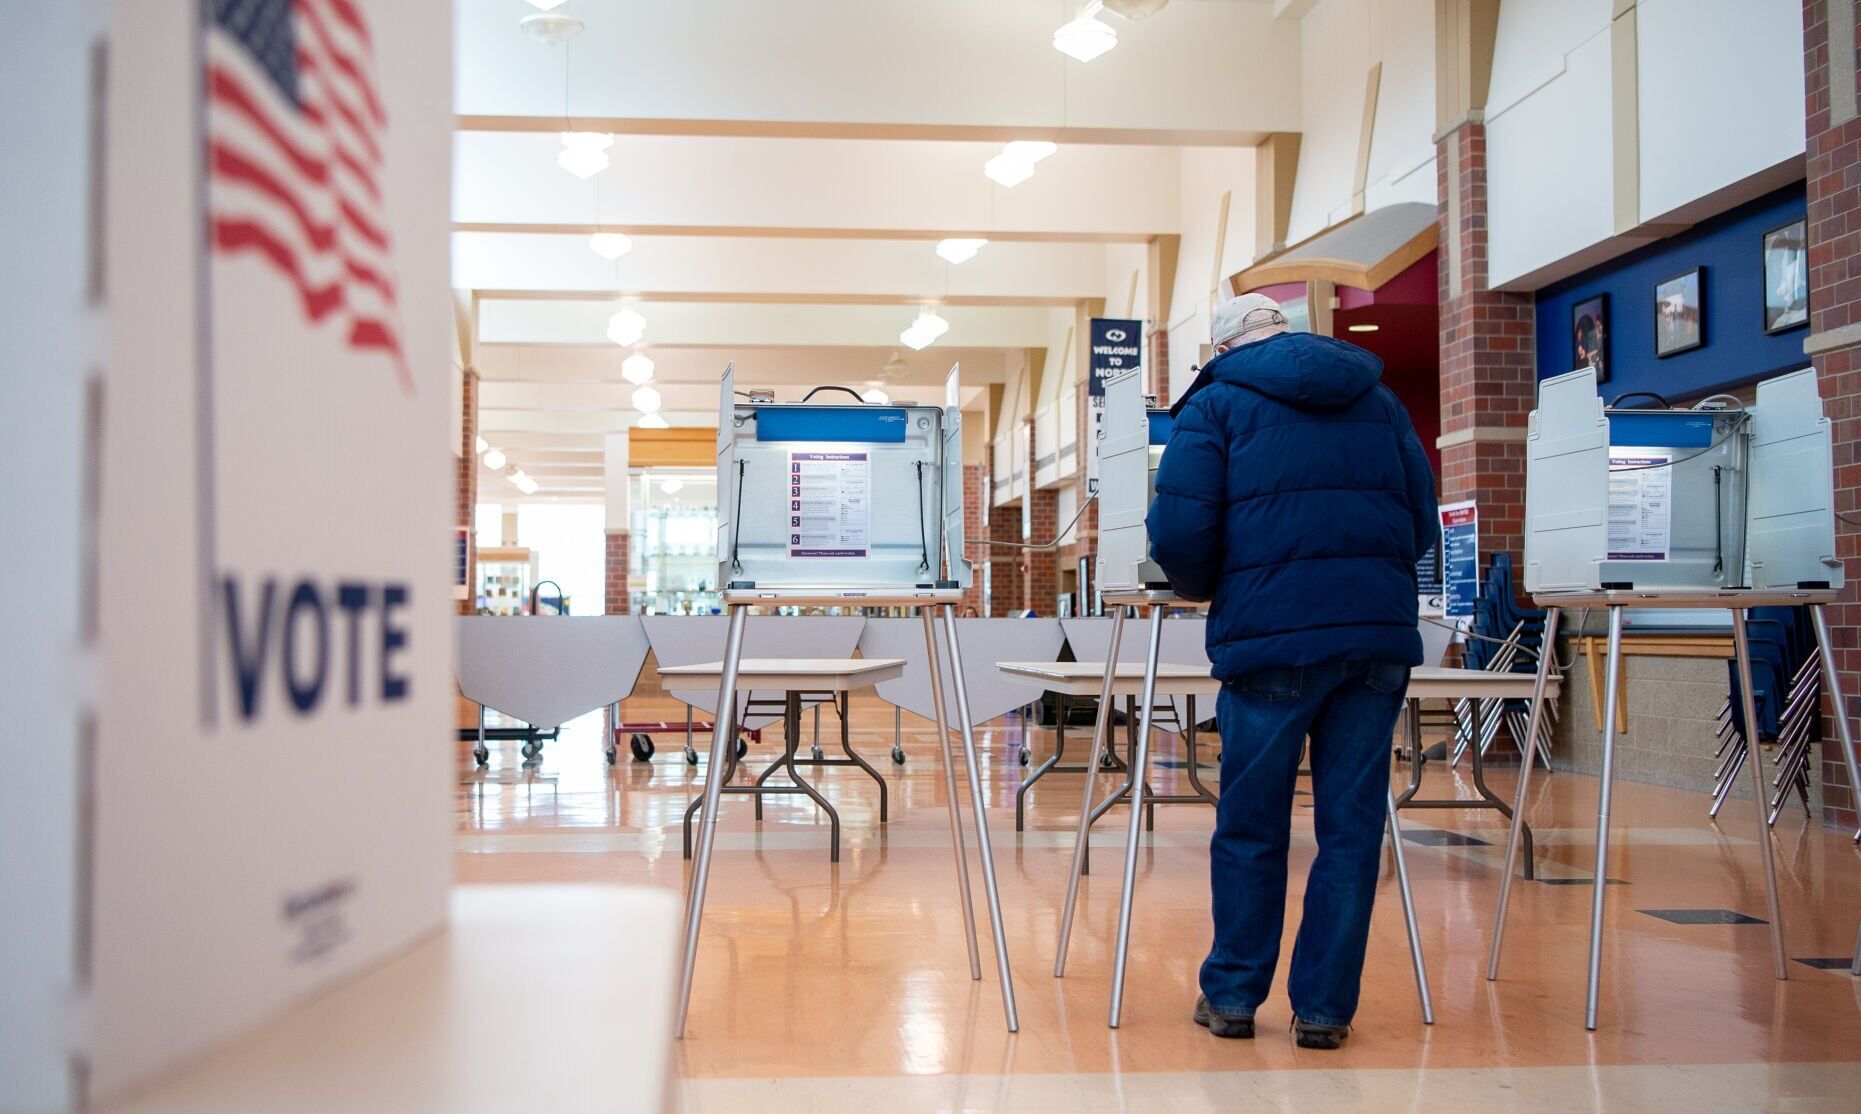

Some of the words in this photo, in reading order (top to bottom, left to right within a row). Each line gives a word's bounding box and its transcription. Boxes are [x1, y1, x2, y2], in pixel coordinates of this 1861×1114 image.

[1093, 345, 1138, 356] WELCOME
[1108, 357, 1123, 366] TO
[1095, 368, 1132, 377] NOR
[222, 577, 411, 722] VOTE
